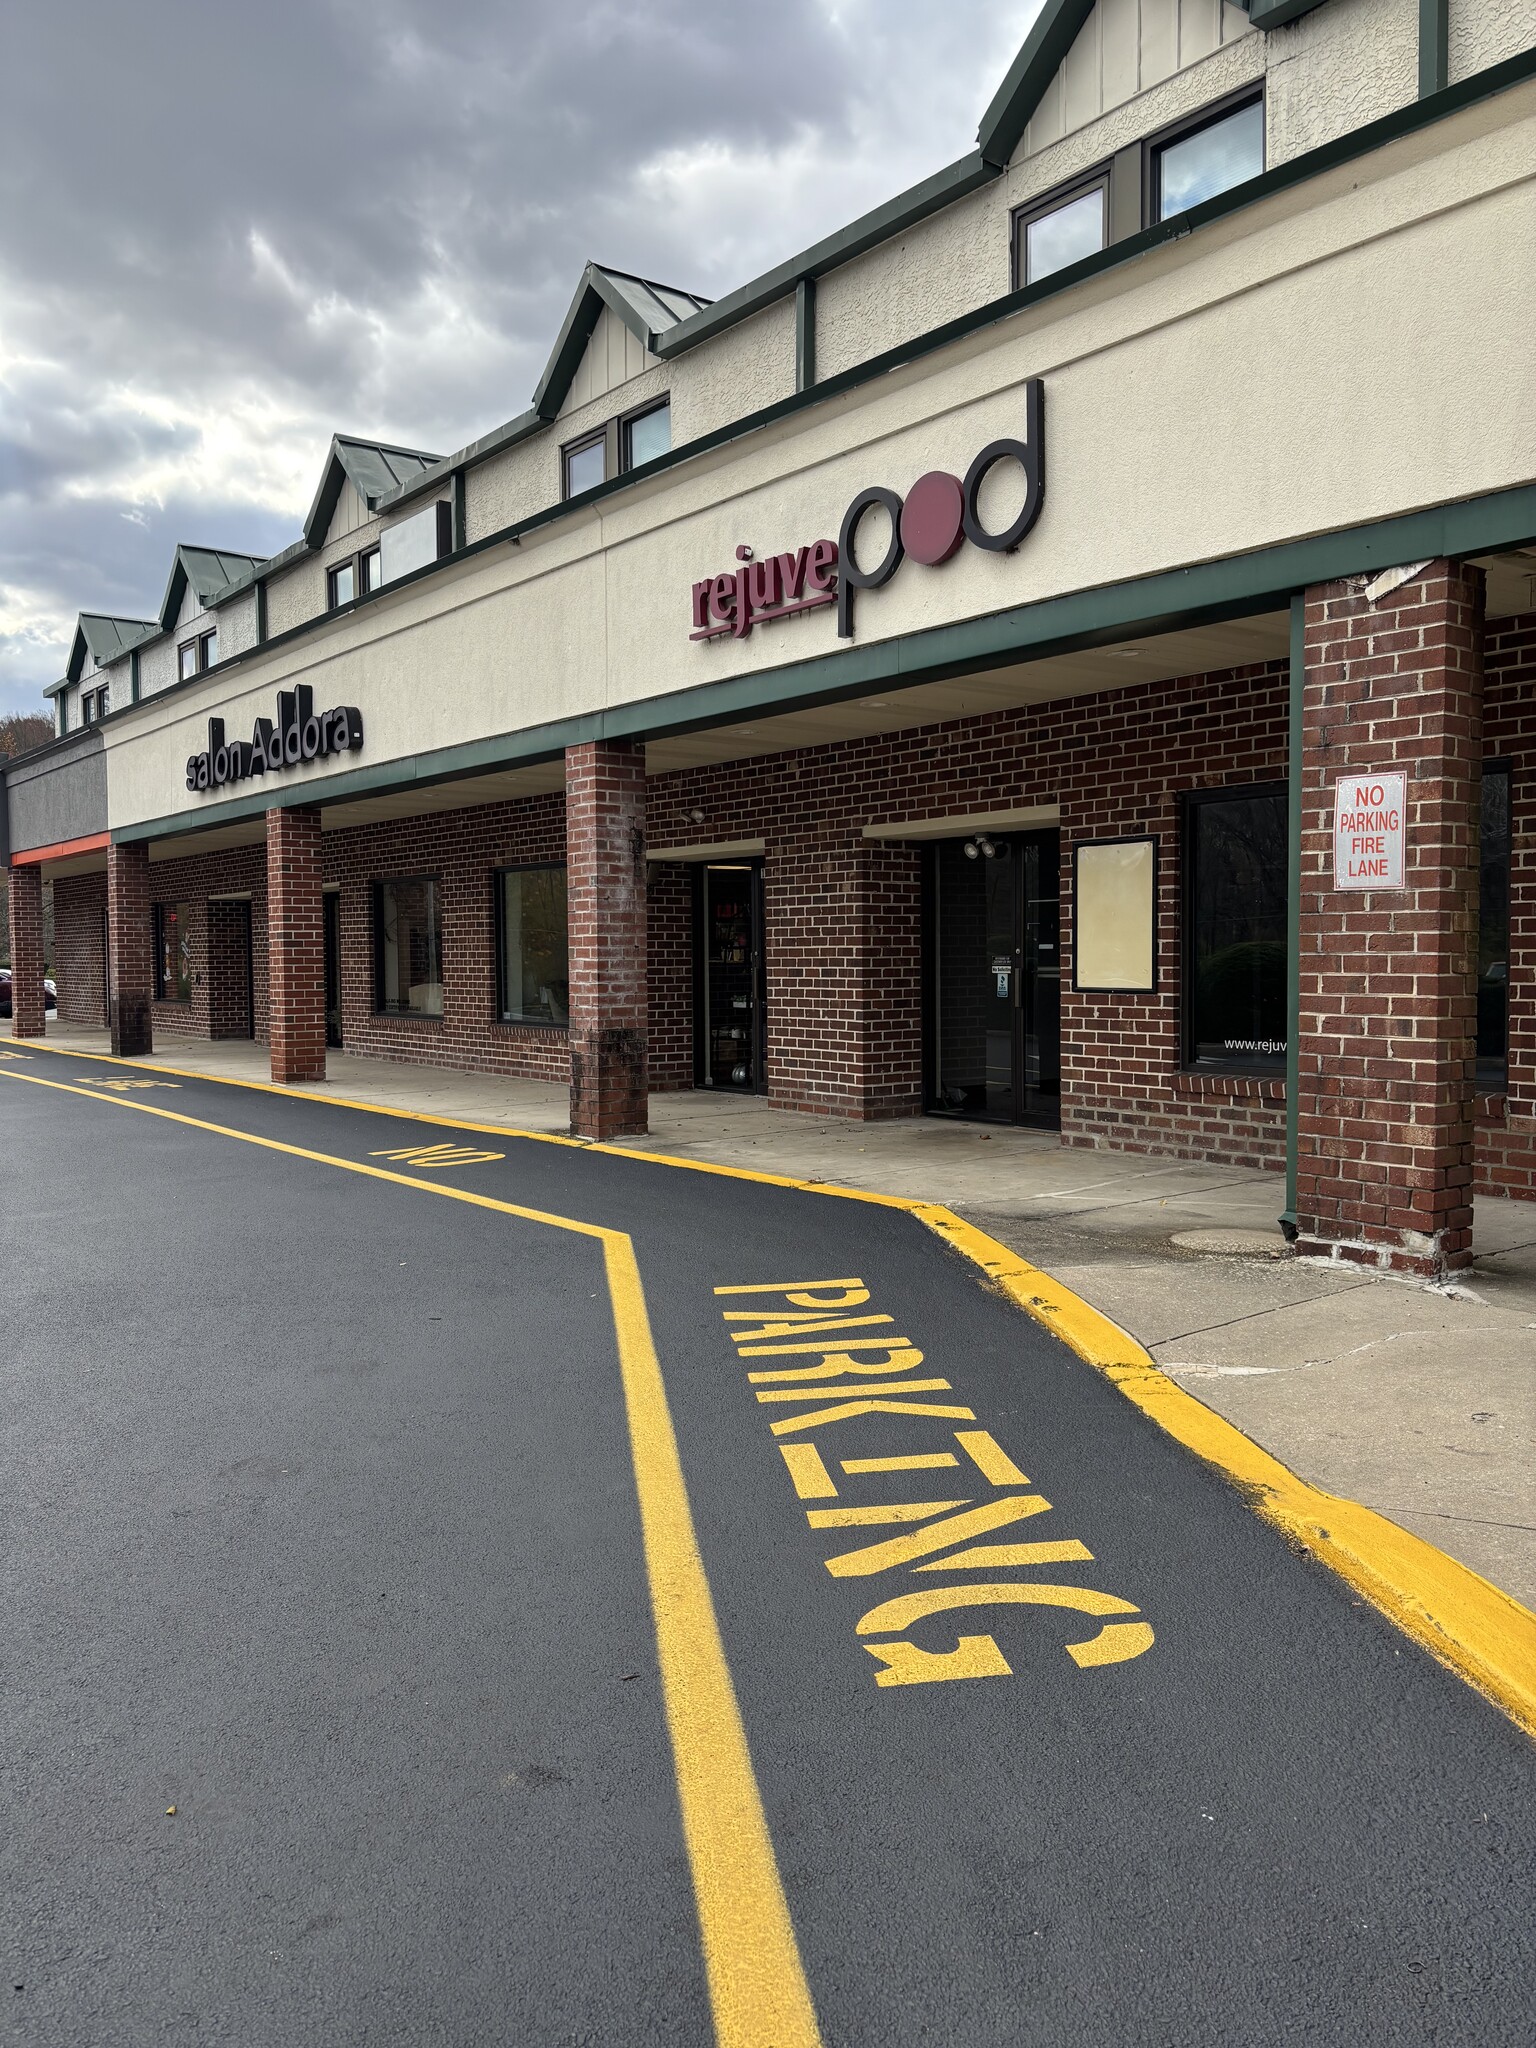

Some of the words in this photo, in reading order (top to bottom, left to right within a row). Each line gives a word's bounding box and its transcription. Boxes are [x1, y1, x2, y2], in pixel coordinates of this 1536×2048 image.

[186, 717, 252, 791] salon
[249, 684, 363, 775] Addora
[1355, 785, 1385, 807] NO
[1340, 809, 1399, 833] PARKING
[1352, 836, 1385, 854] FIRE
[1348, 859, 1389, 877] LANE
[366, 1143, 506, 1167] NO
[713, 1278, 1155, 1687] PARKING
